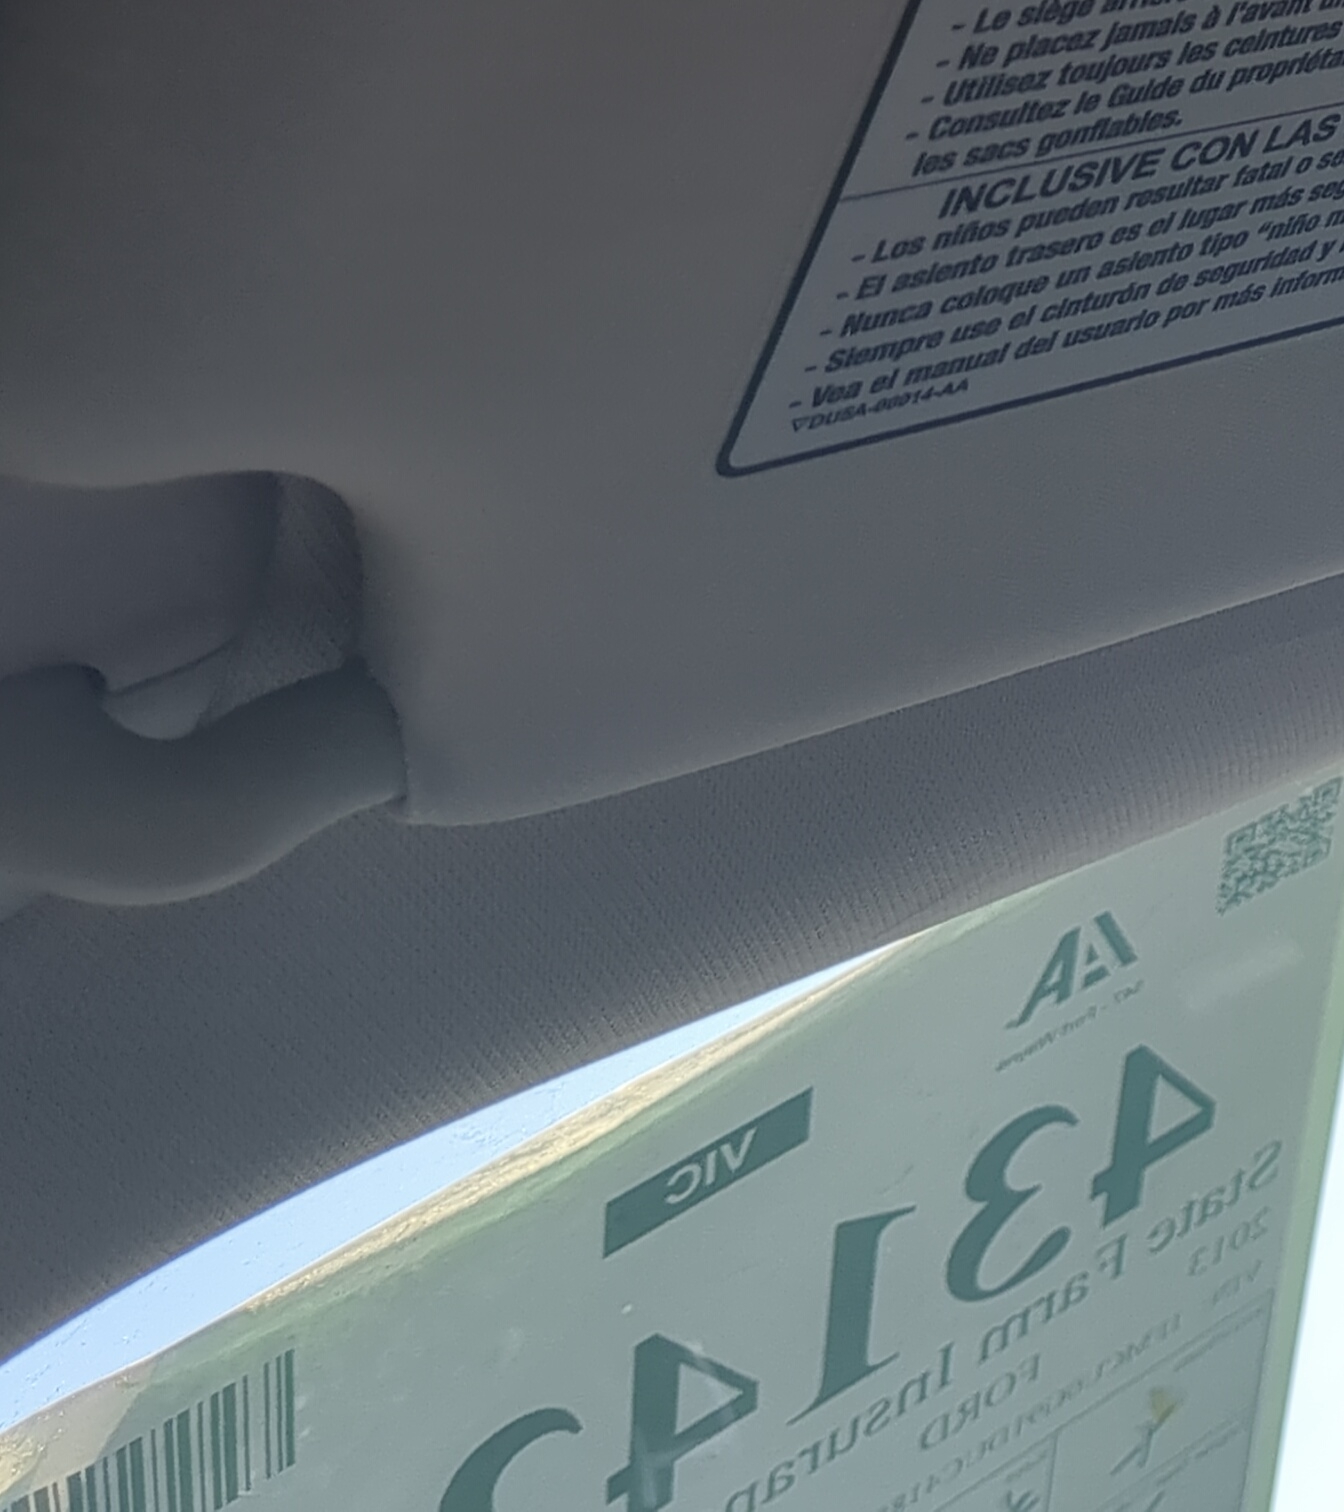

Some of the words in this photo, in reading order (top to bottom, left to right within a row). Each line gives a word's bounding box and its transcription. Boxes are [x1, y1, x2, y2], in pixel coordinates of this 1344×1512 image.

[927, 98, 1070, 141] Consultez
[1072, 90, 1101, 115] le
[1106, 75, 1184, 108] Guide
[1188, 68, 1226, 94] du
[942, 69, 1052, 106] Utilisez
[1056, 49, 1172, 85] toujours
[1176, 40, 1219, 65] les
[1222, 20, 1343, 57] ceintures
[911, 150, 957, 177] les
[962, 137, 1031, 166] sacs
[1035, 109, 1181, 157] gonflables.
[938, 147, 1165, 218] INCLUSIVE
[1170, 129, 1259, 171] CON
[1262, 113, 1341, 154] LAS
[854, 273, 887, 301] El
[890, 253, 999, 293] asiento
[1004, 230, 1105, 267] trasero
[1108, 222, 1143, 245] es
[1146, 210, 1177, 237] el
[1176, 199, 1248, 230] lugar
[1248, 185, 1305, 215] más
[823, 330, 944, 373] Siempre
[948, 316, 1002, 344] use
[1007, 304, 1038, 331] el
[1039, 281, 1151, 323] cinturón
[1155, 271, 1190, 296] de
[1193, 239, 1318, 287] seguridad
[1315, 238, 1337, 262] y
